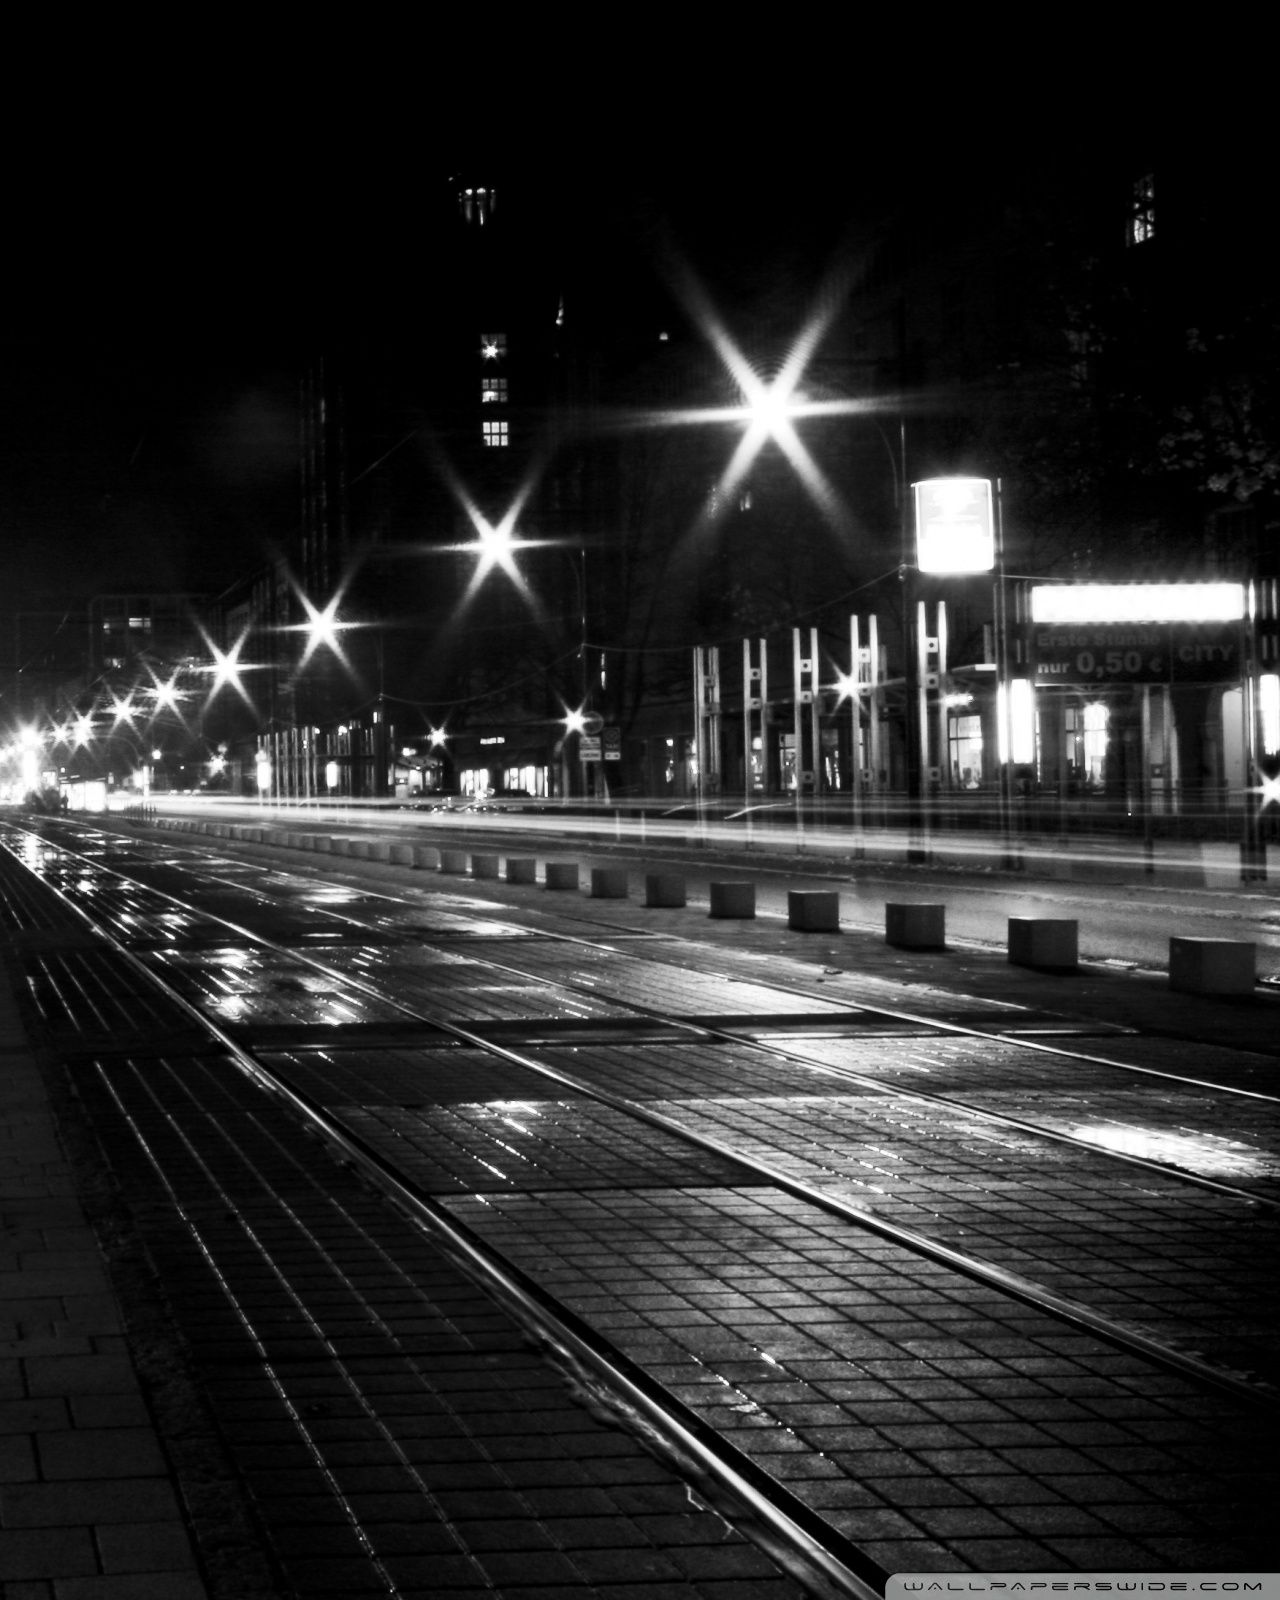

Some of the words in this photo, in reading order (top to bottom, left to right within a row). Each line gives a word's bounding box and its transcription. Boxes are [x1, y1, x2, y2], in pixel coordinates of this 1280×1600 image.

[1037, 632, 1088, 647] Erste
[1093, 630, 1160, 647] Stunde
[1177, 644, 1234, 662] CITY
[1037, 661, 1070, 674] nur
[1075, 651, 1143, 678] 0,50
[1149, 656, 1163, 673] €
